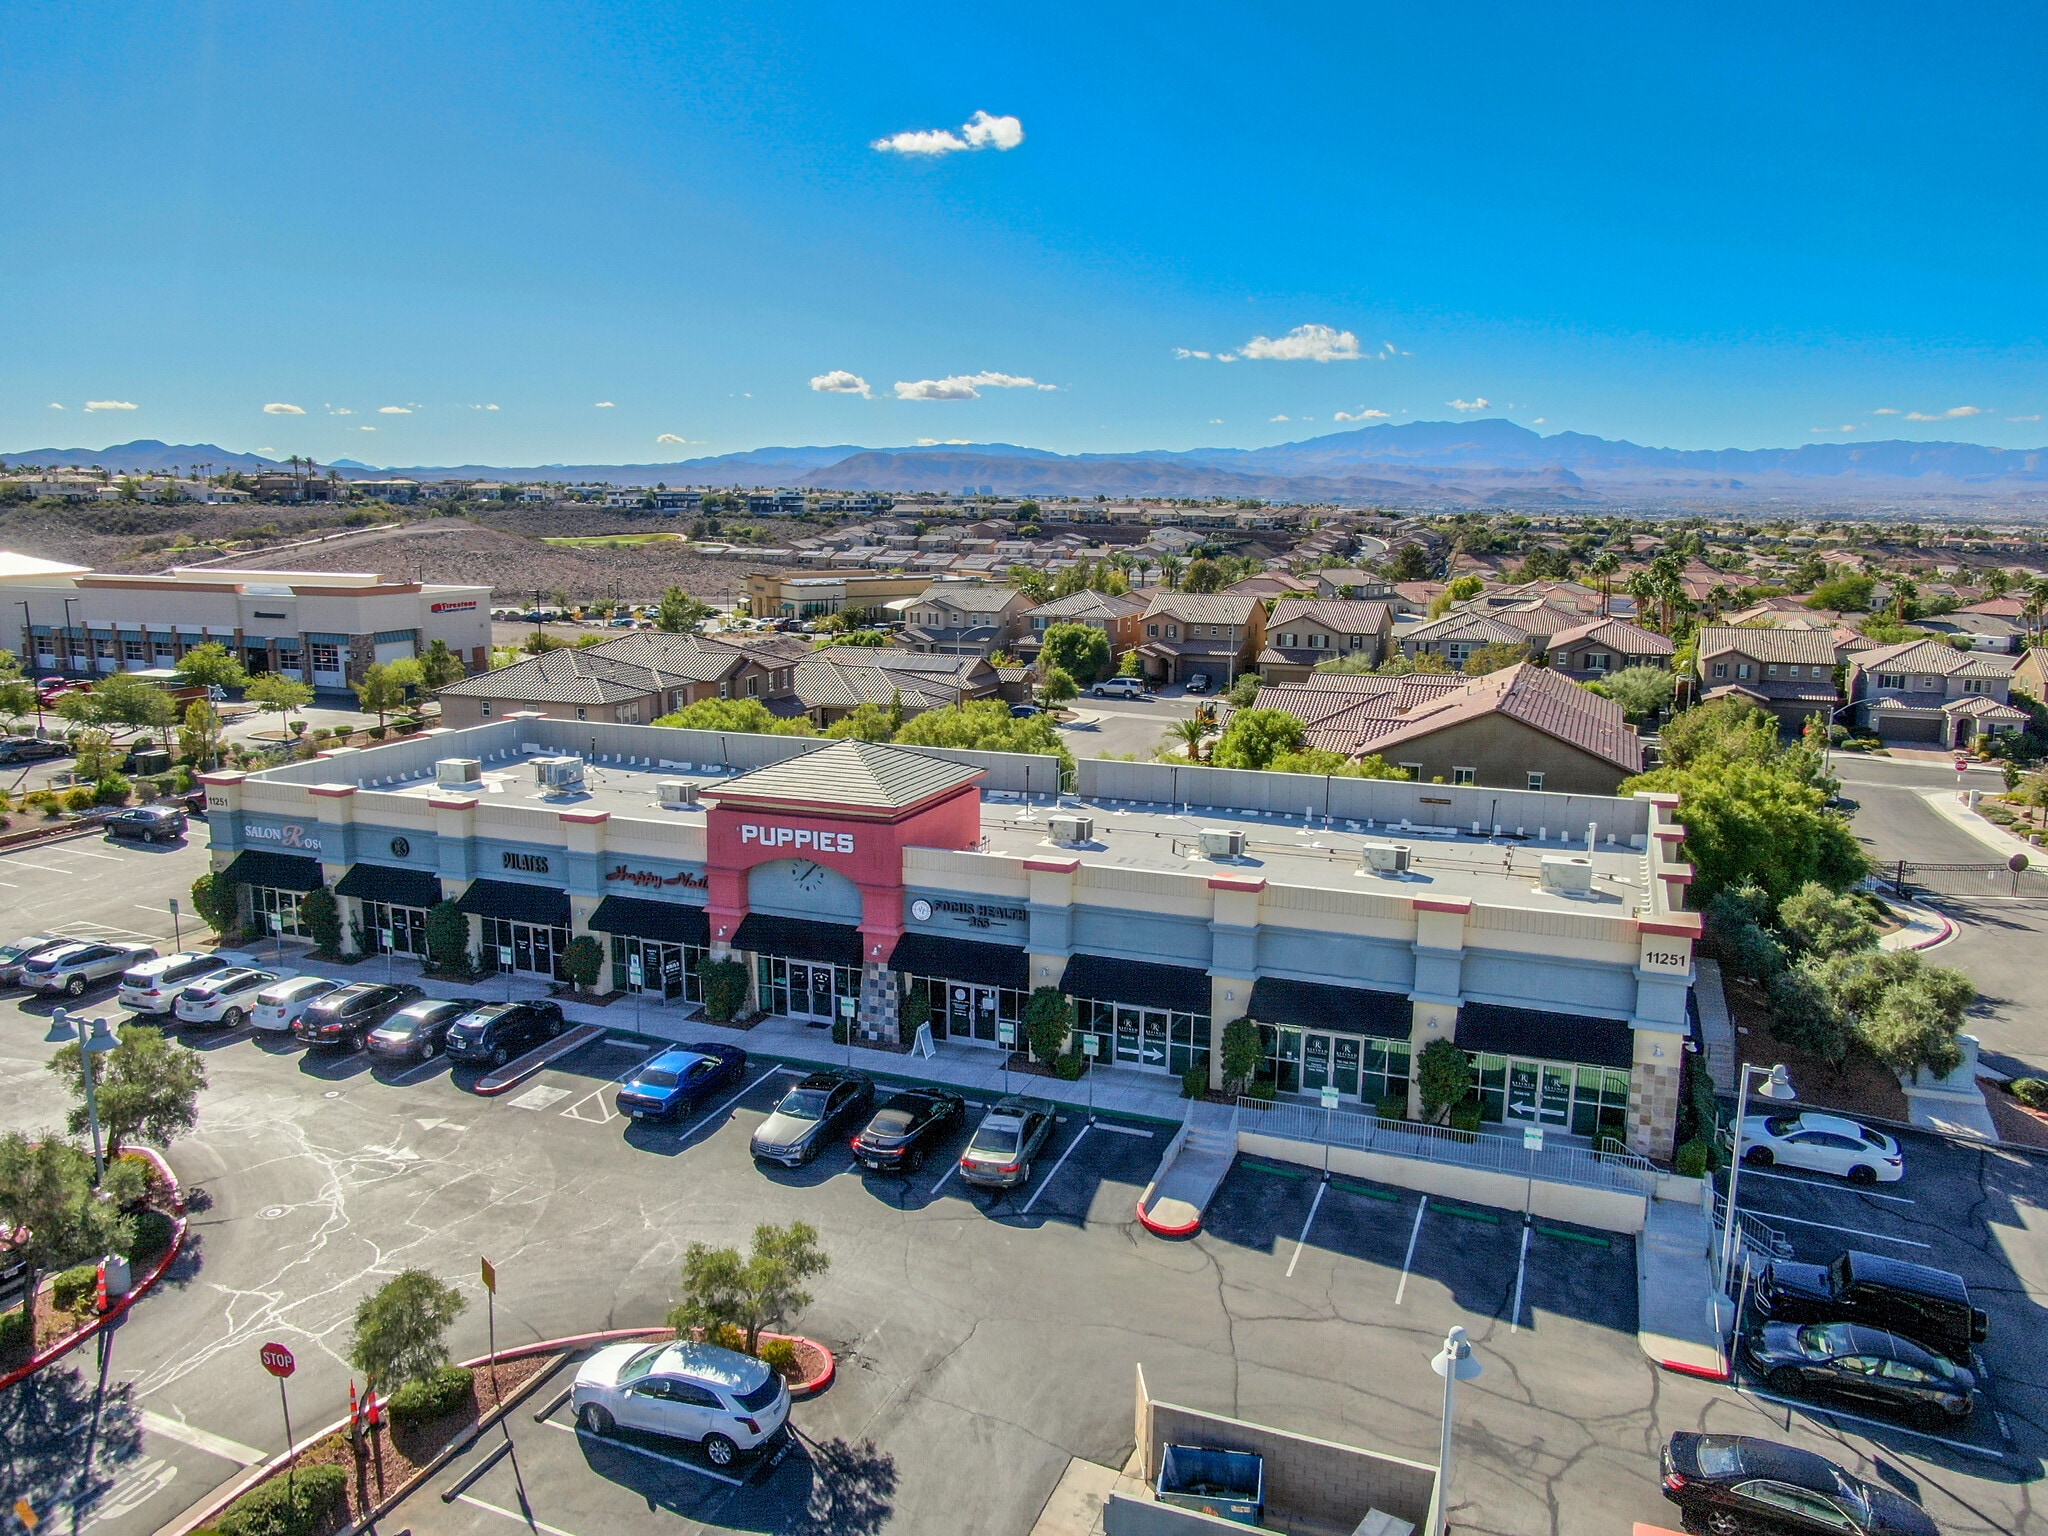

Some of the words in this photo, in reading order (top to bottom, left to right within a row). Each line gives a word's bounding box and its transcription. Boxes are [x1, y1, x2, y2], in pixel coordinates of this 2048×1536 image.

[441, 601, 477, 610] Firestone
[208, 797, 229, 807] 11251
[244, 825, 281, 840] SALON
[281, 825, 322, 849] ROS
[741, 824, 855, 854] PUPPIES
[502, 851, 549, 874] PILATES
[605, 864, 663, 889] Happy
[662, 871, 709, 891] Nail
[933, 900, 976, 915] FOCUS
[977, 904, 1027, 921] HEALTH
[968, 916, 991, 929] 365
[1646, 951, 1686, 967] 11251
[262, 1351, 292, 1368] STOP
